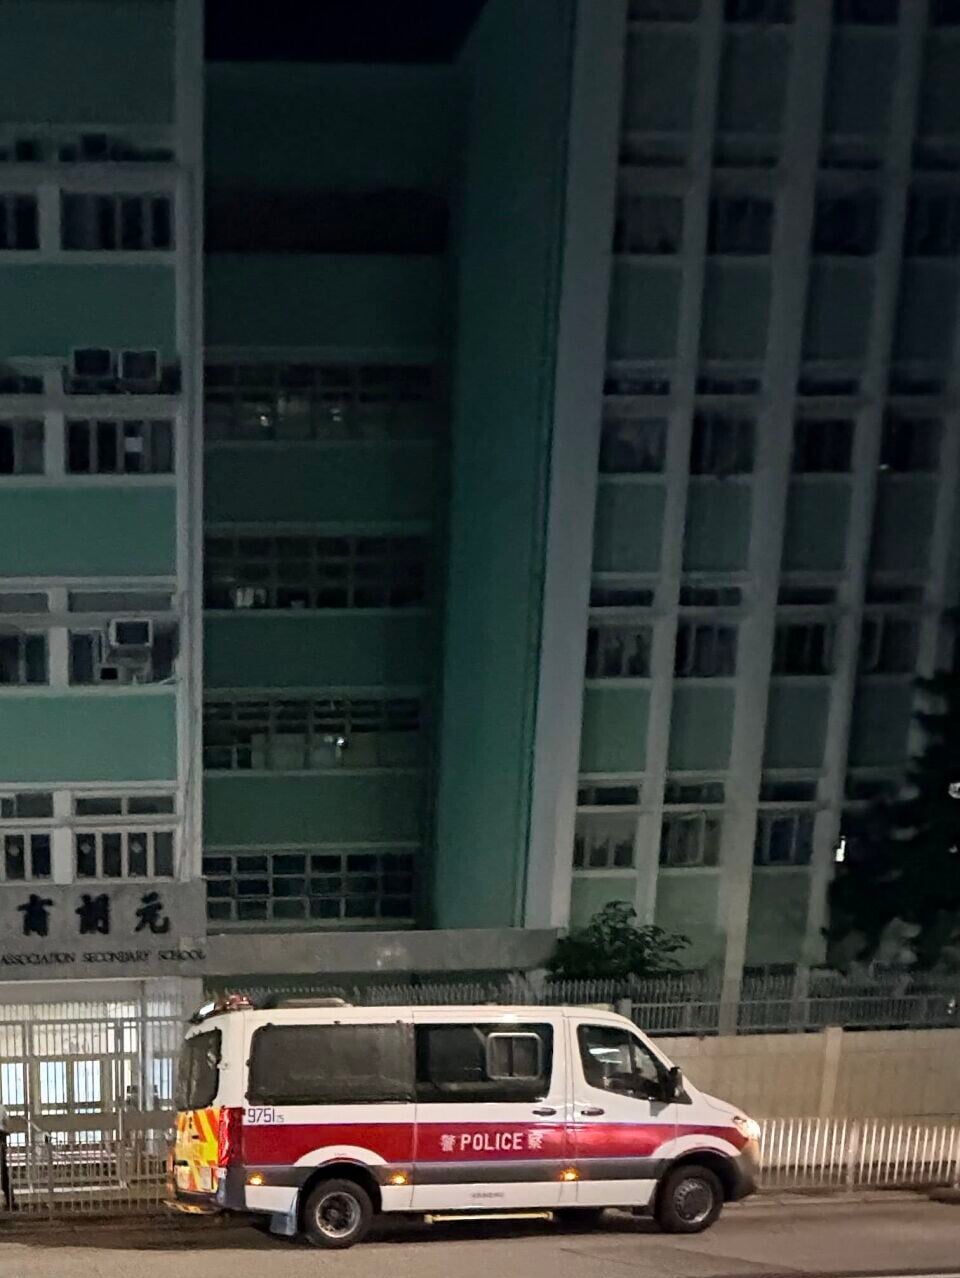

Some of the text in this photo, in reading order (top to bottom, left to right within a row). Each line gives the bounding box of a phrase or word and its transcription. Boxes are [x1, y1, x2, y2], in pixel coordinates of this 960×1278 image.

[0, 952, 76, 966] ASSOCIATION
[248, 1107, 276, 1123] 9751
[460, 1132, 524, 1151] POLICE
